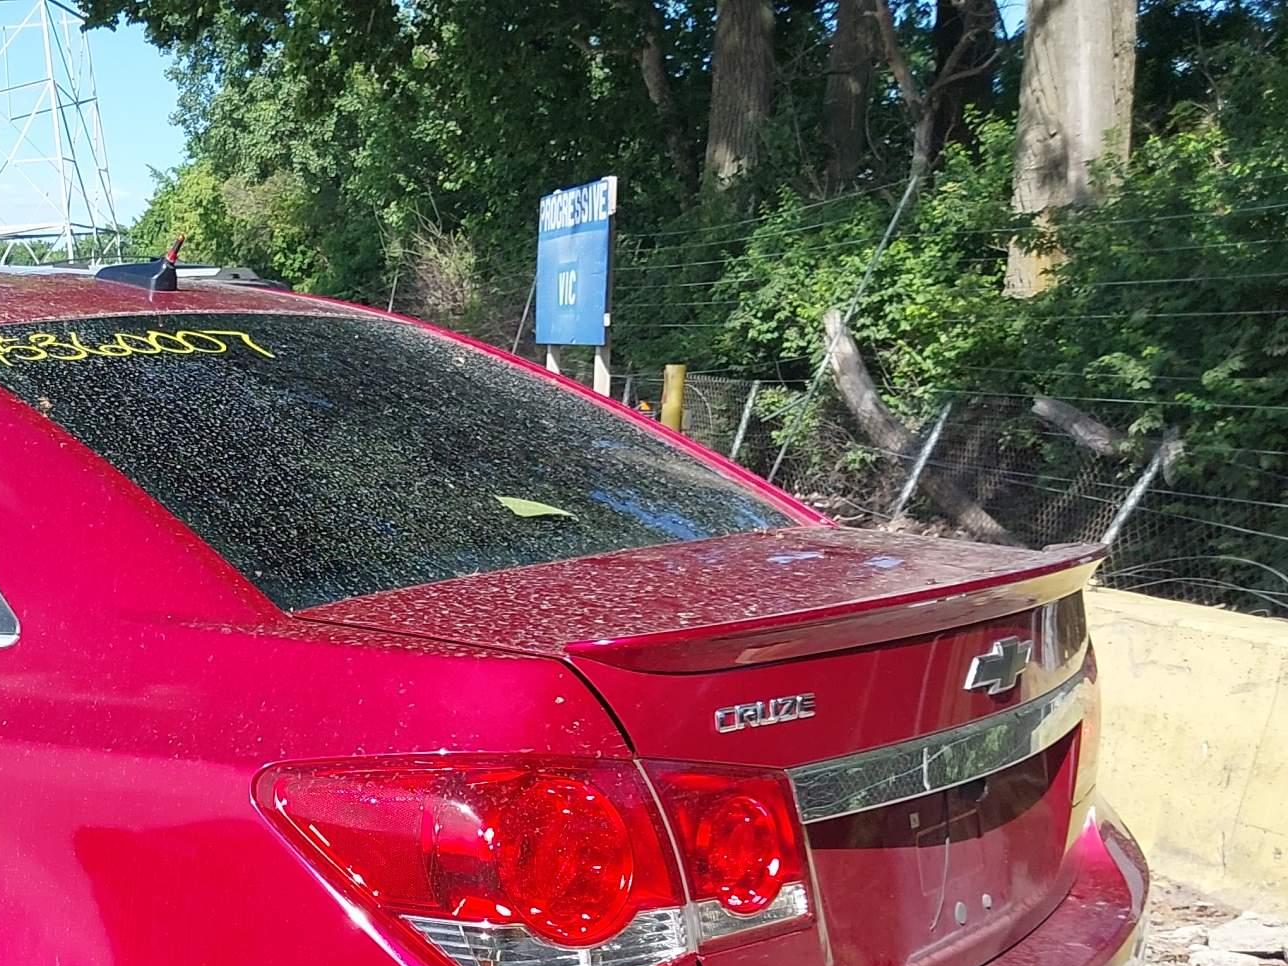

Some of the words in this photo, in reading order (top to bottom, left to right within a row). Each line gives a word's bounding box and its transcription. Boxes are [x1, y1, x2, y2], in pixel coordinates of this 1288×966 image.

[539, 181, 608, 232] PROGRESSIVE
[558, 269, 576, 306] VIC
[714, 692, 816, 734] CRUZE
